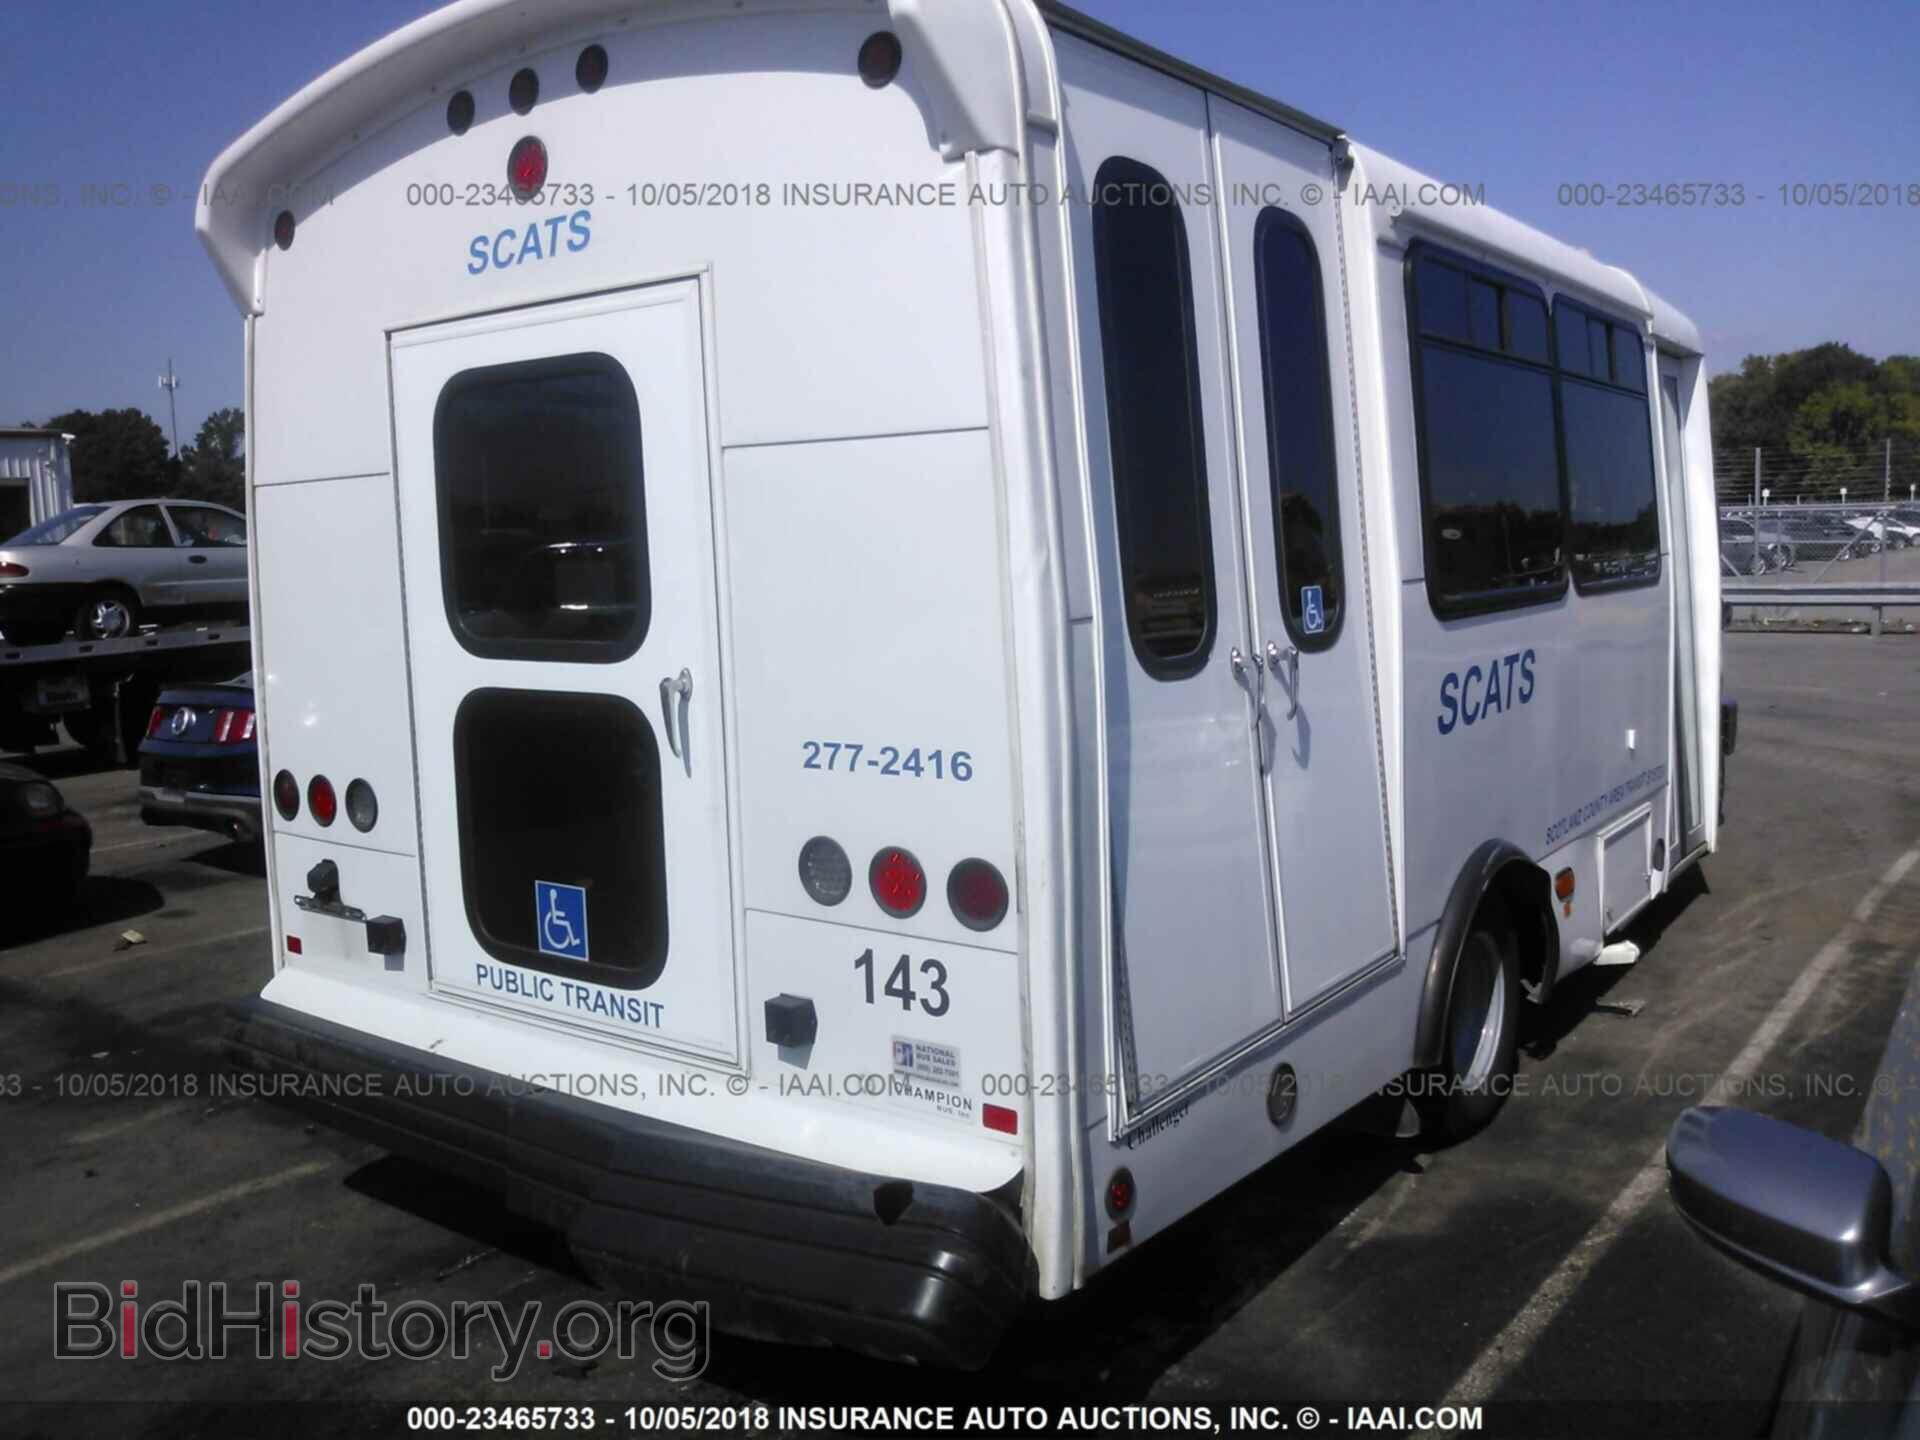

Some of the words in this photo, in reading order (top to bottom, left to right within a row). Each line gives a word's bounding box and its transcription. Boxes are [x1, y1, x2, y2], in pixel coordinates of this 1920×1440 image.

[467, 209, 592, 275] SCATS
[1437, 648, 1536, 735] SCATS
[802, 740, 973, 782] 277-2416
[475, 963, 555, 1002] PUBLIC
[560, 981, 666, 1029] TRANSIT
[854, 947, 951, 1018] 143
[915, 1043, 956, 1058] NATIONAL
[895, 1081, 973, 1111] CHAMPION
[1126, 1100, 1190, 1150] Challenger
